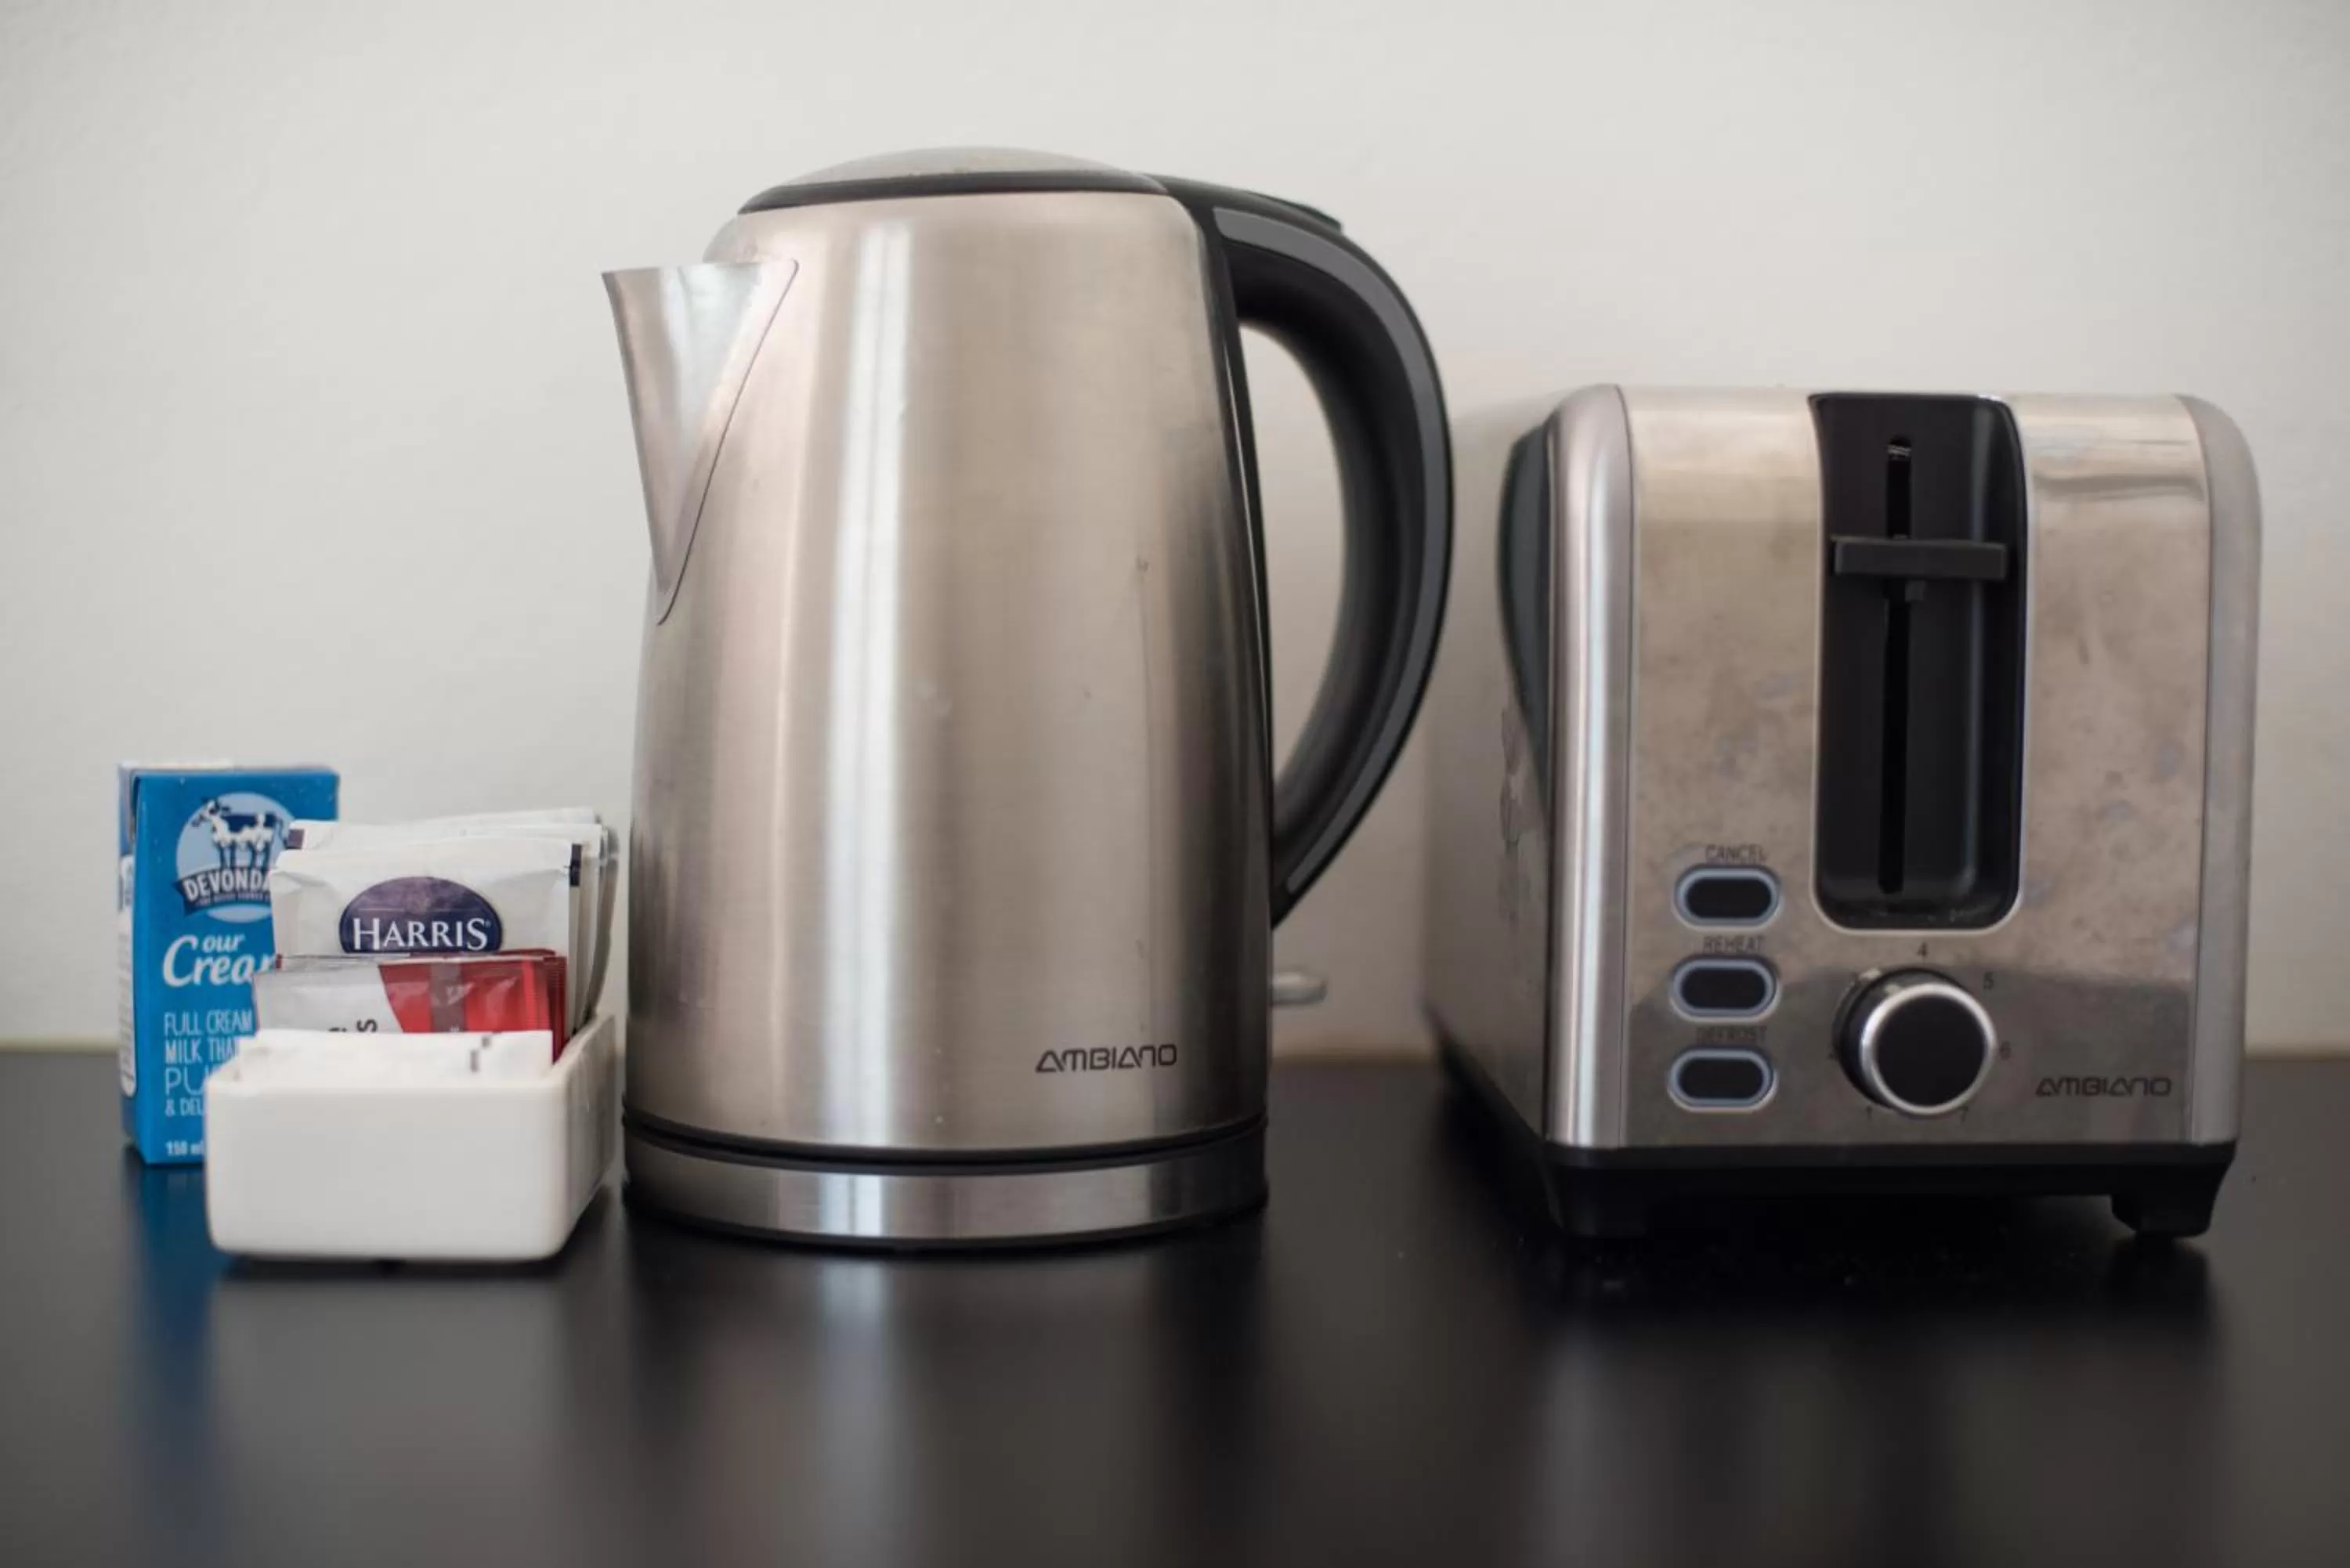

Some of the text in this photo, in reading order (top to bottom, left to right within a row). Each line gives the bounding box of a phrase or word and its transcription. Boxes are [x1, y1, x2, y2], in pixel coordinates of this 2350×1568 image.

[1705, 844, 1769, 864] CANCEL
[201, 934, 245, 952] our
[353, 918, 487, 951] HARRIS
[1703, 934, 1765, 955] REHEAT
[1918, 942, 1929, 958] 4
[164, 1009, 253, 1035] FULL CREAM
[1696, 1024, 1768, 1044] DEFROST
[165, 1039, 203, 1064] MILK
[1035, 1044, 1177, 1072] AMBIANO
[2036, 1076, 2172, 1097] AMBIANO
